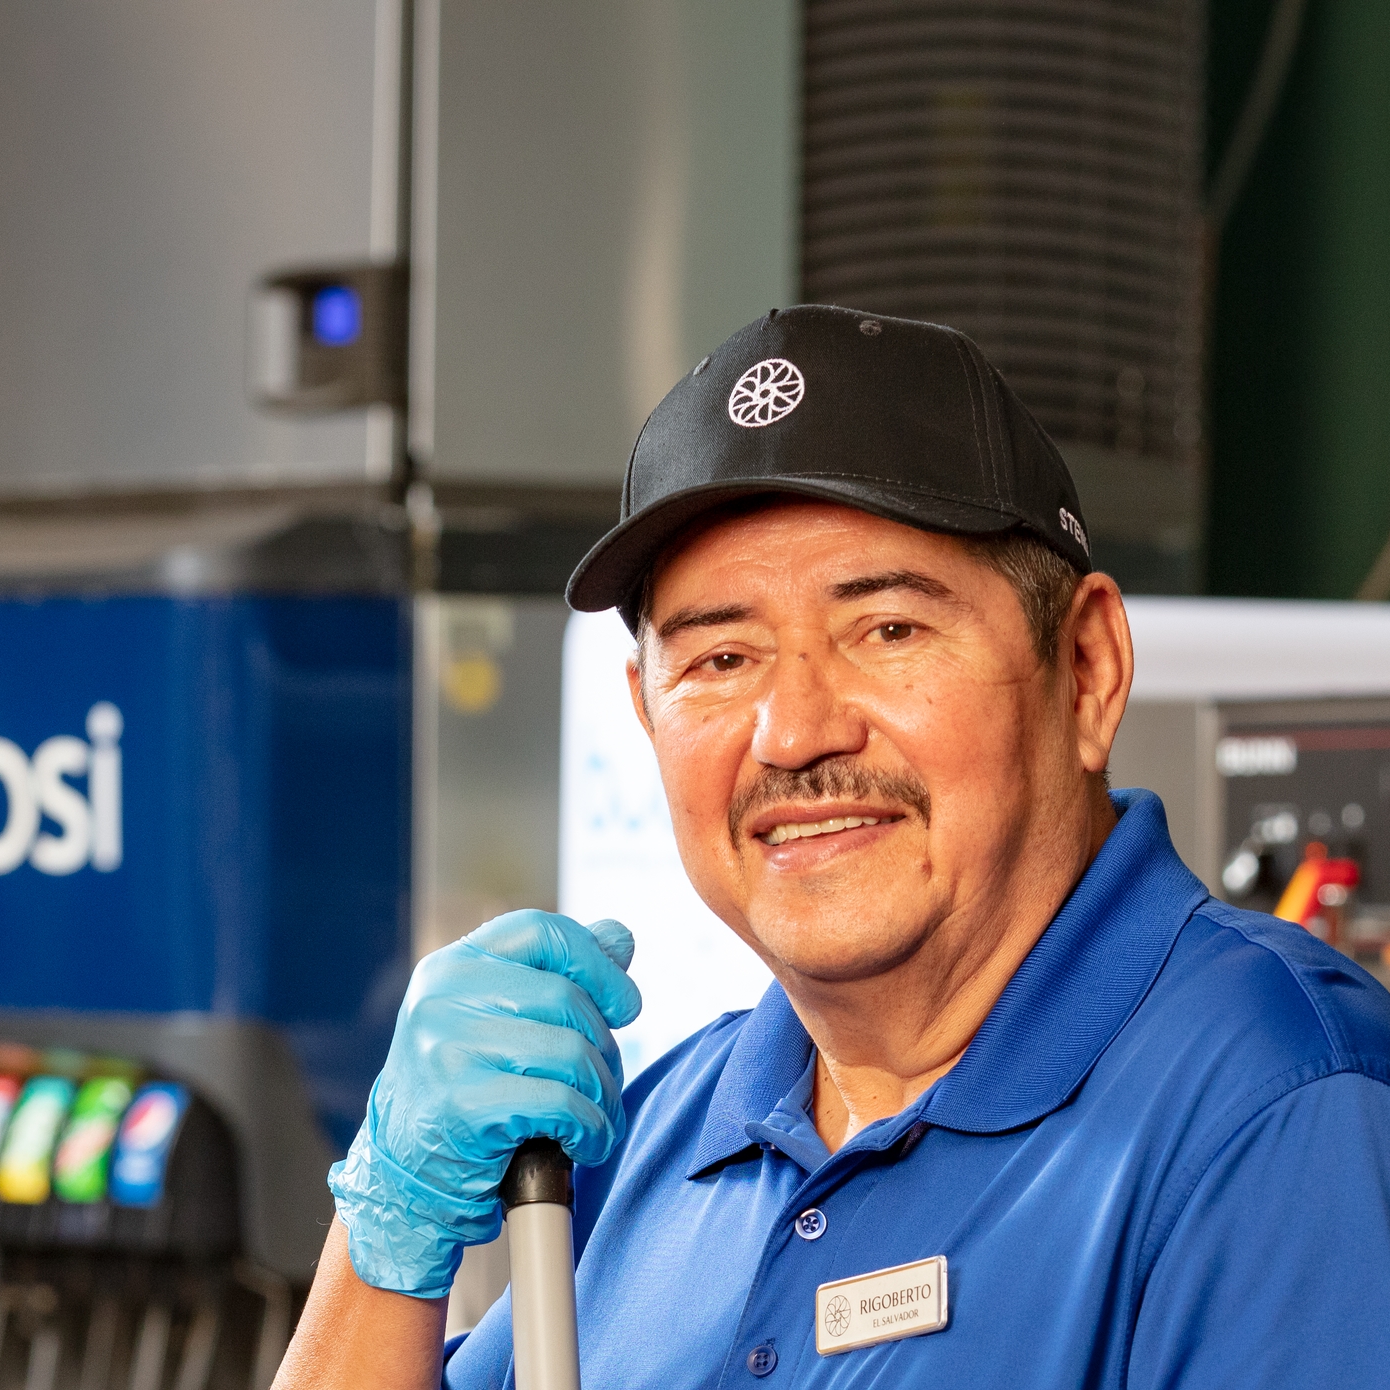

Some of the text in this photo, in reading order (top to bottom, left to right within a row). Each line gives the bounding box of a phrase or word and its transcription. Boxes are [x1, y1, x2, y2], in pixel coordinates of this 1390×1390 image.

[1059, 507, 1089, 557] STE
[860, 1283, 931, 1315] RIGOBERTO
[872, 1309, 919, 1328] EL SALVADOR
